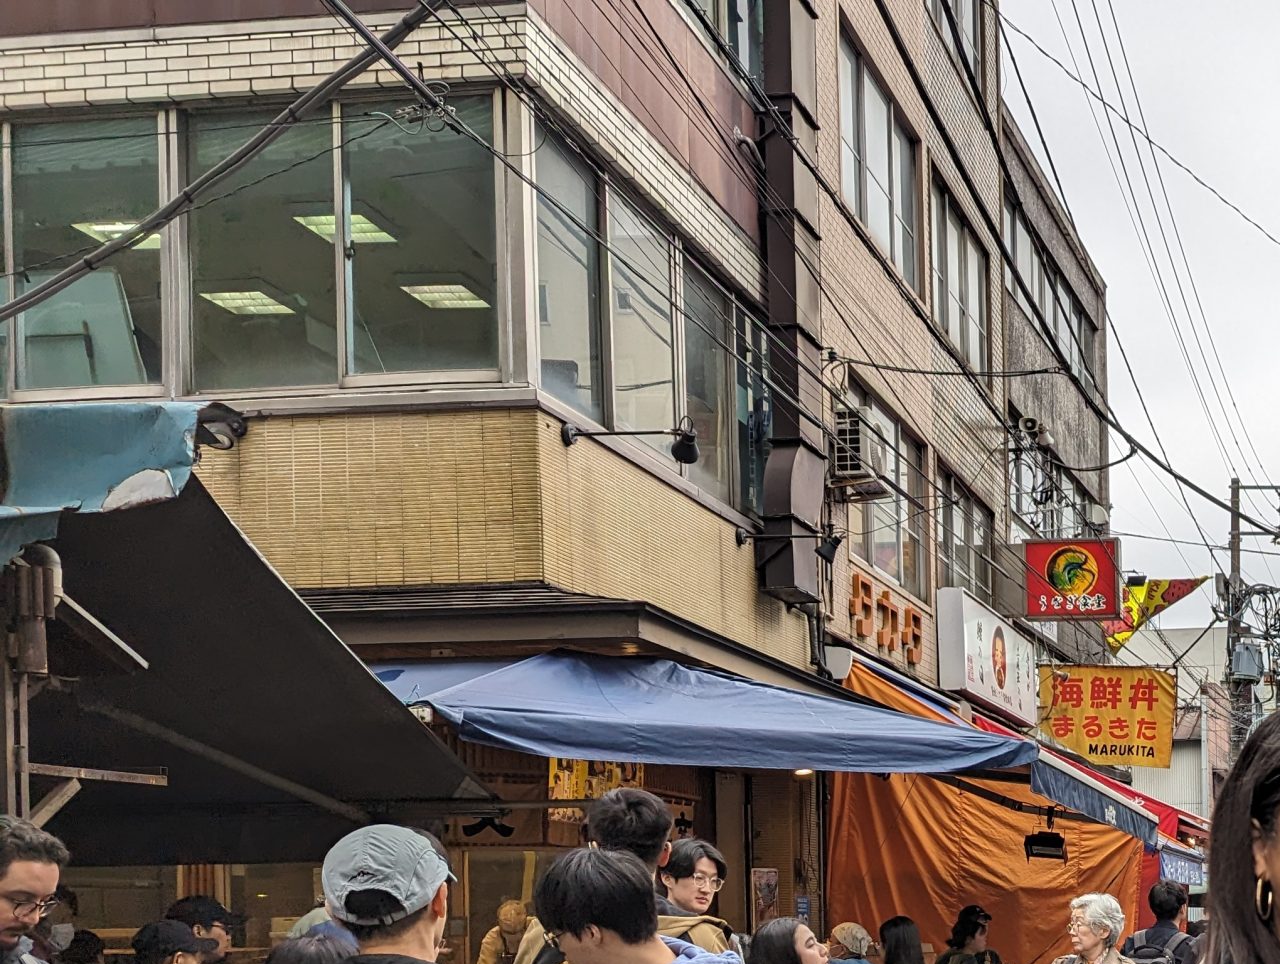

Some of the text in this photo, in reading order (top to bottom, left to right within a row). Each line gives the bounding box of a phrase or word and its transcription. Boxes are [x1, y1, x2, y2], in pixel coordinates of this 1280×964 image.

[1052, 676, 1159, 712] 海鮮丼
[1052, 715, 1158, 741] まるきた
[1088, 743, 1155, 758] MARUKITA
